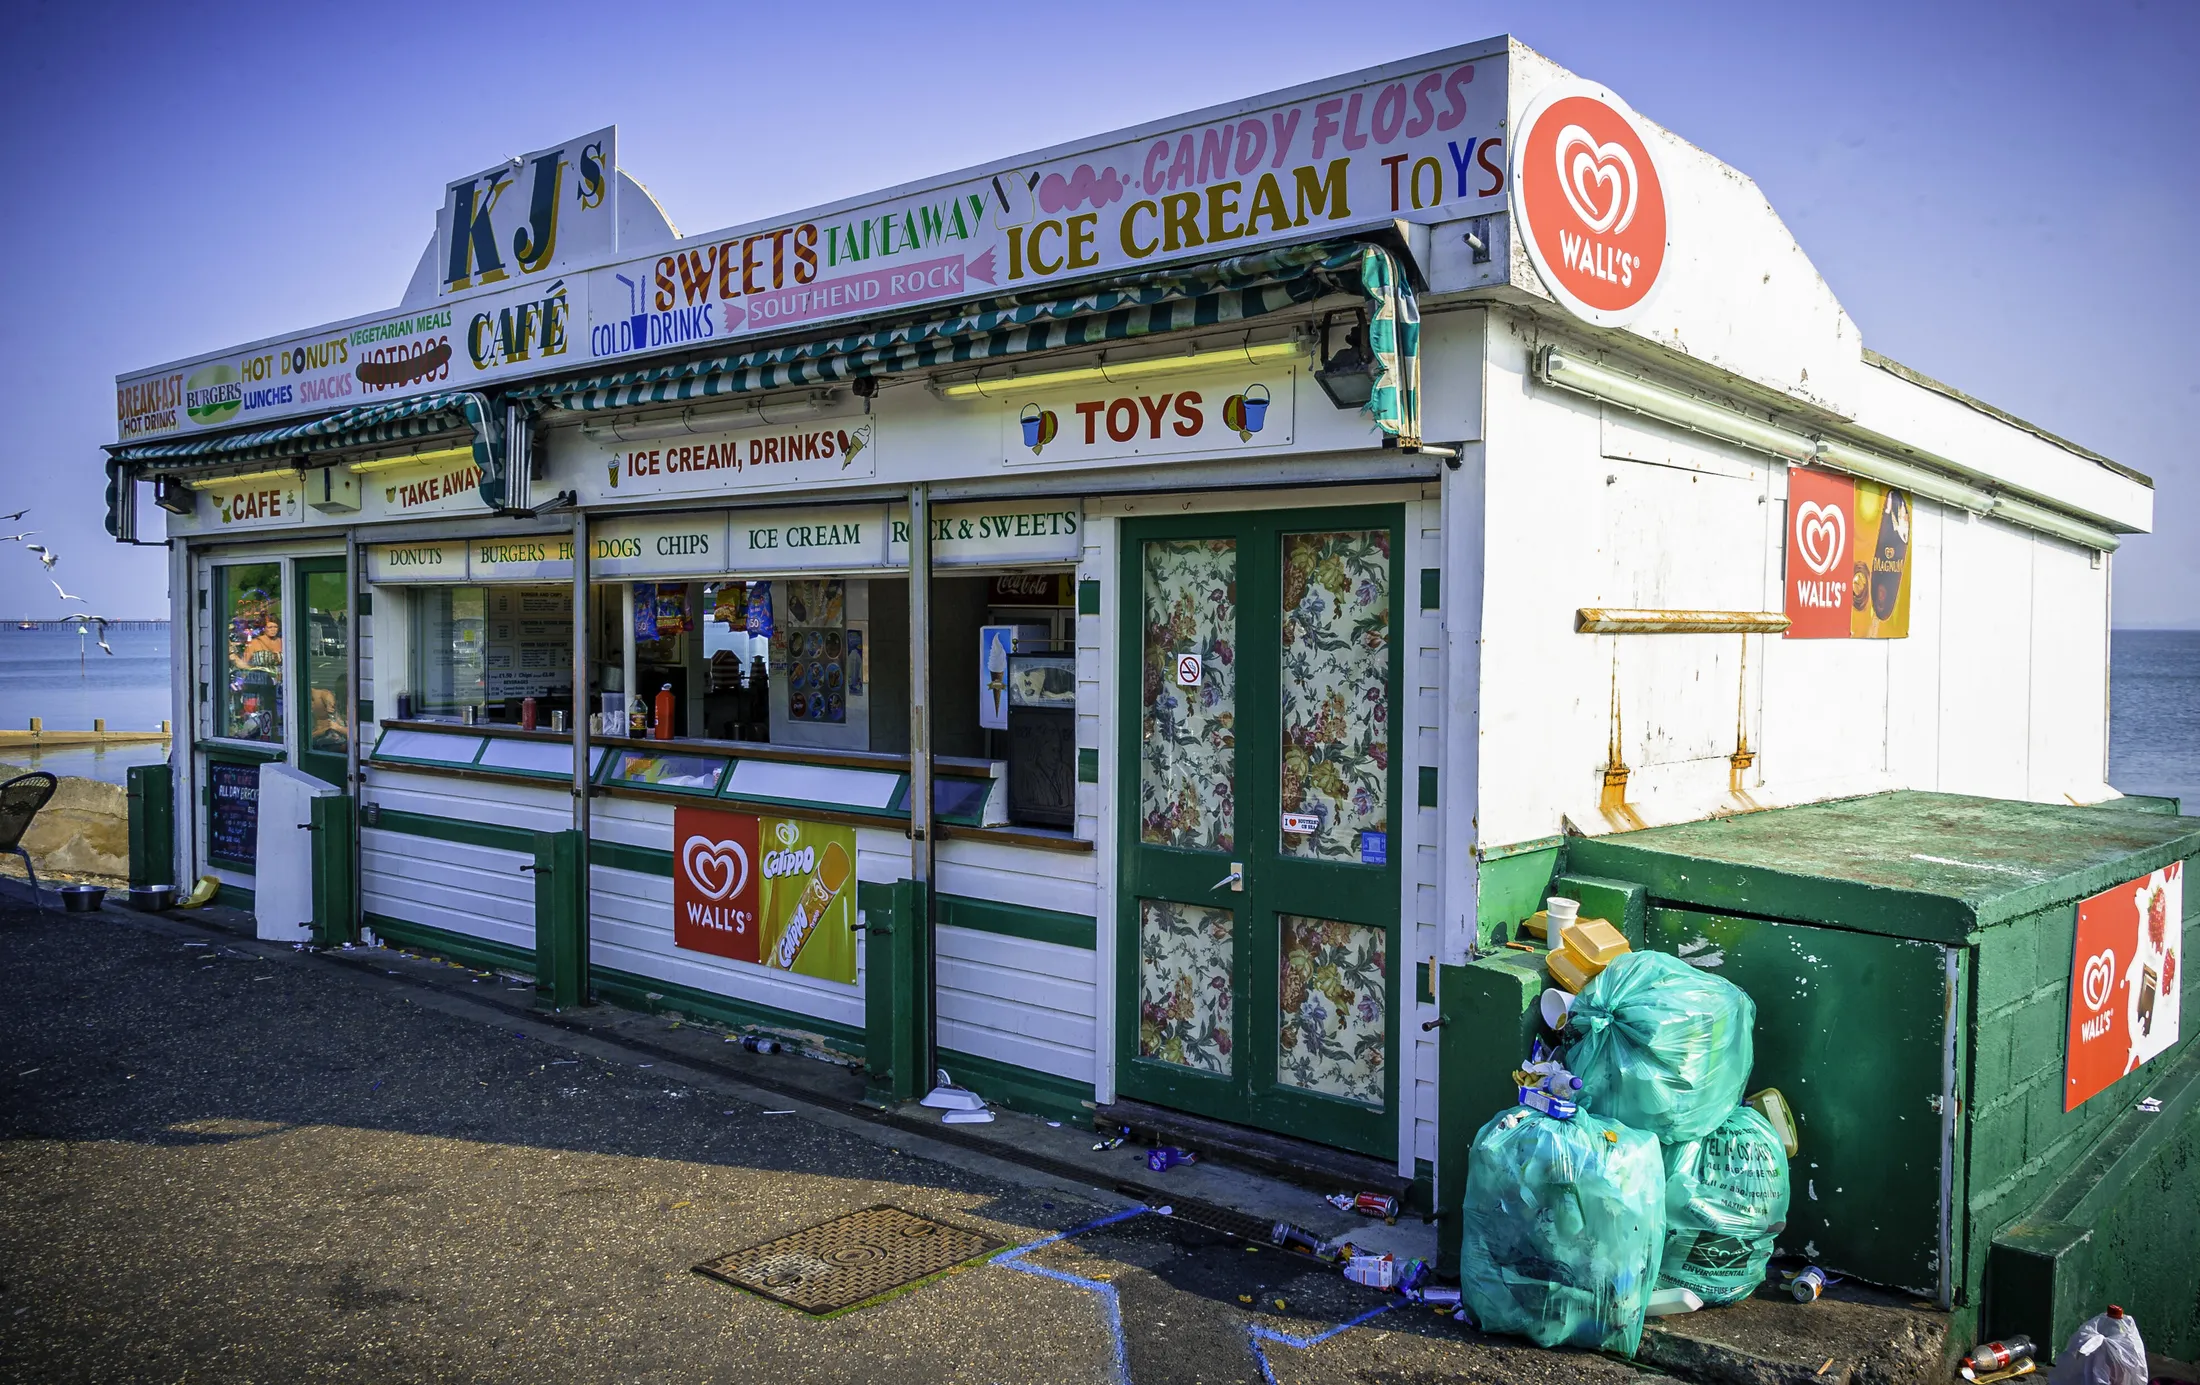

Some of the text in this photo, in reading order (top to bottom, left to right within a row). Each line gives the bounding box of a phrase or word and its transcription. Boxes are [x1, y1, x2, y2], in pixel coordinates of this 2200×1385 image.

[1143, 65, 1475, 195] CANDY FLOSS
[1380, 137, 1506, 212] TOYS
[824, 190, 990, 268] TAKEAWAY
[1006, 156, 1352, 281] ICE CREAM
[655, 223, 818, 312] SWEETS
[750, 263, 960, 321] SOUTHEND ROCK
[350, 310, 452, 347] VEGETARIAN MEALS
[467, 279, 569, 371] CAFÉ
[592, 303, 714, 357] COLD DRINKS
[241, 338, 348, 384] HOT DONUTS
[361, 335, 450, 395] HOTDOGS
[117, 374, 184, 421] BREAKFAST
[186, 382, 242, 408] BURGERS
[243, 373, 351, 411] LUNCHES SNACKS
[123, 410, 177, 435] HOT DRINKS
[1076, 391, 1203, 444] TOYS
[628, 431, 835, 477] ICE CREAM, DRINKS
[232, 489, 281, 520] CAFE
[399, 465, 483, 508] TAKE AWAY
[597, 537, 641, 558] DOGS
[656, 533, 709, 556] CHIPS
[748, 523, 860, 550] ICE CREAM
[958, 518, 974, 540] &
[979, 511, 1077, 539] SWEETS
[390, 548, 442, 566] DONUTS
[480, 543, 545, 564] BURGERS
[763, 845, 815, 880] Calippo
[1681, 1263, 1745, 1277] ENVIRONMENTAL
